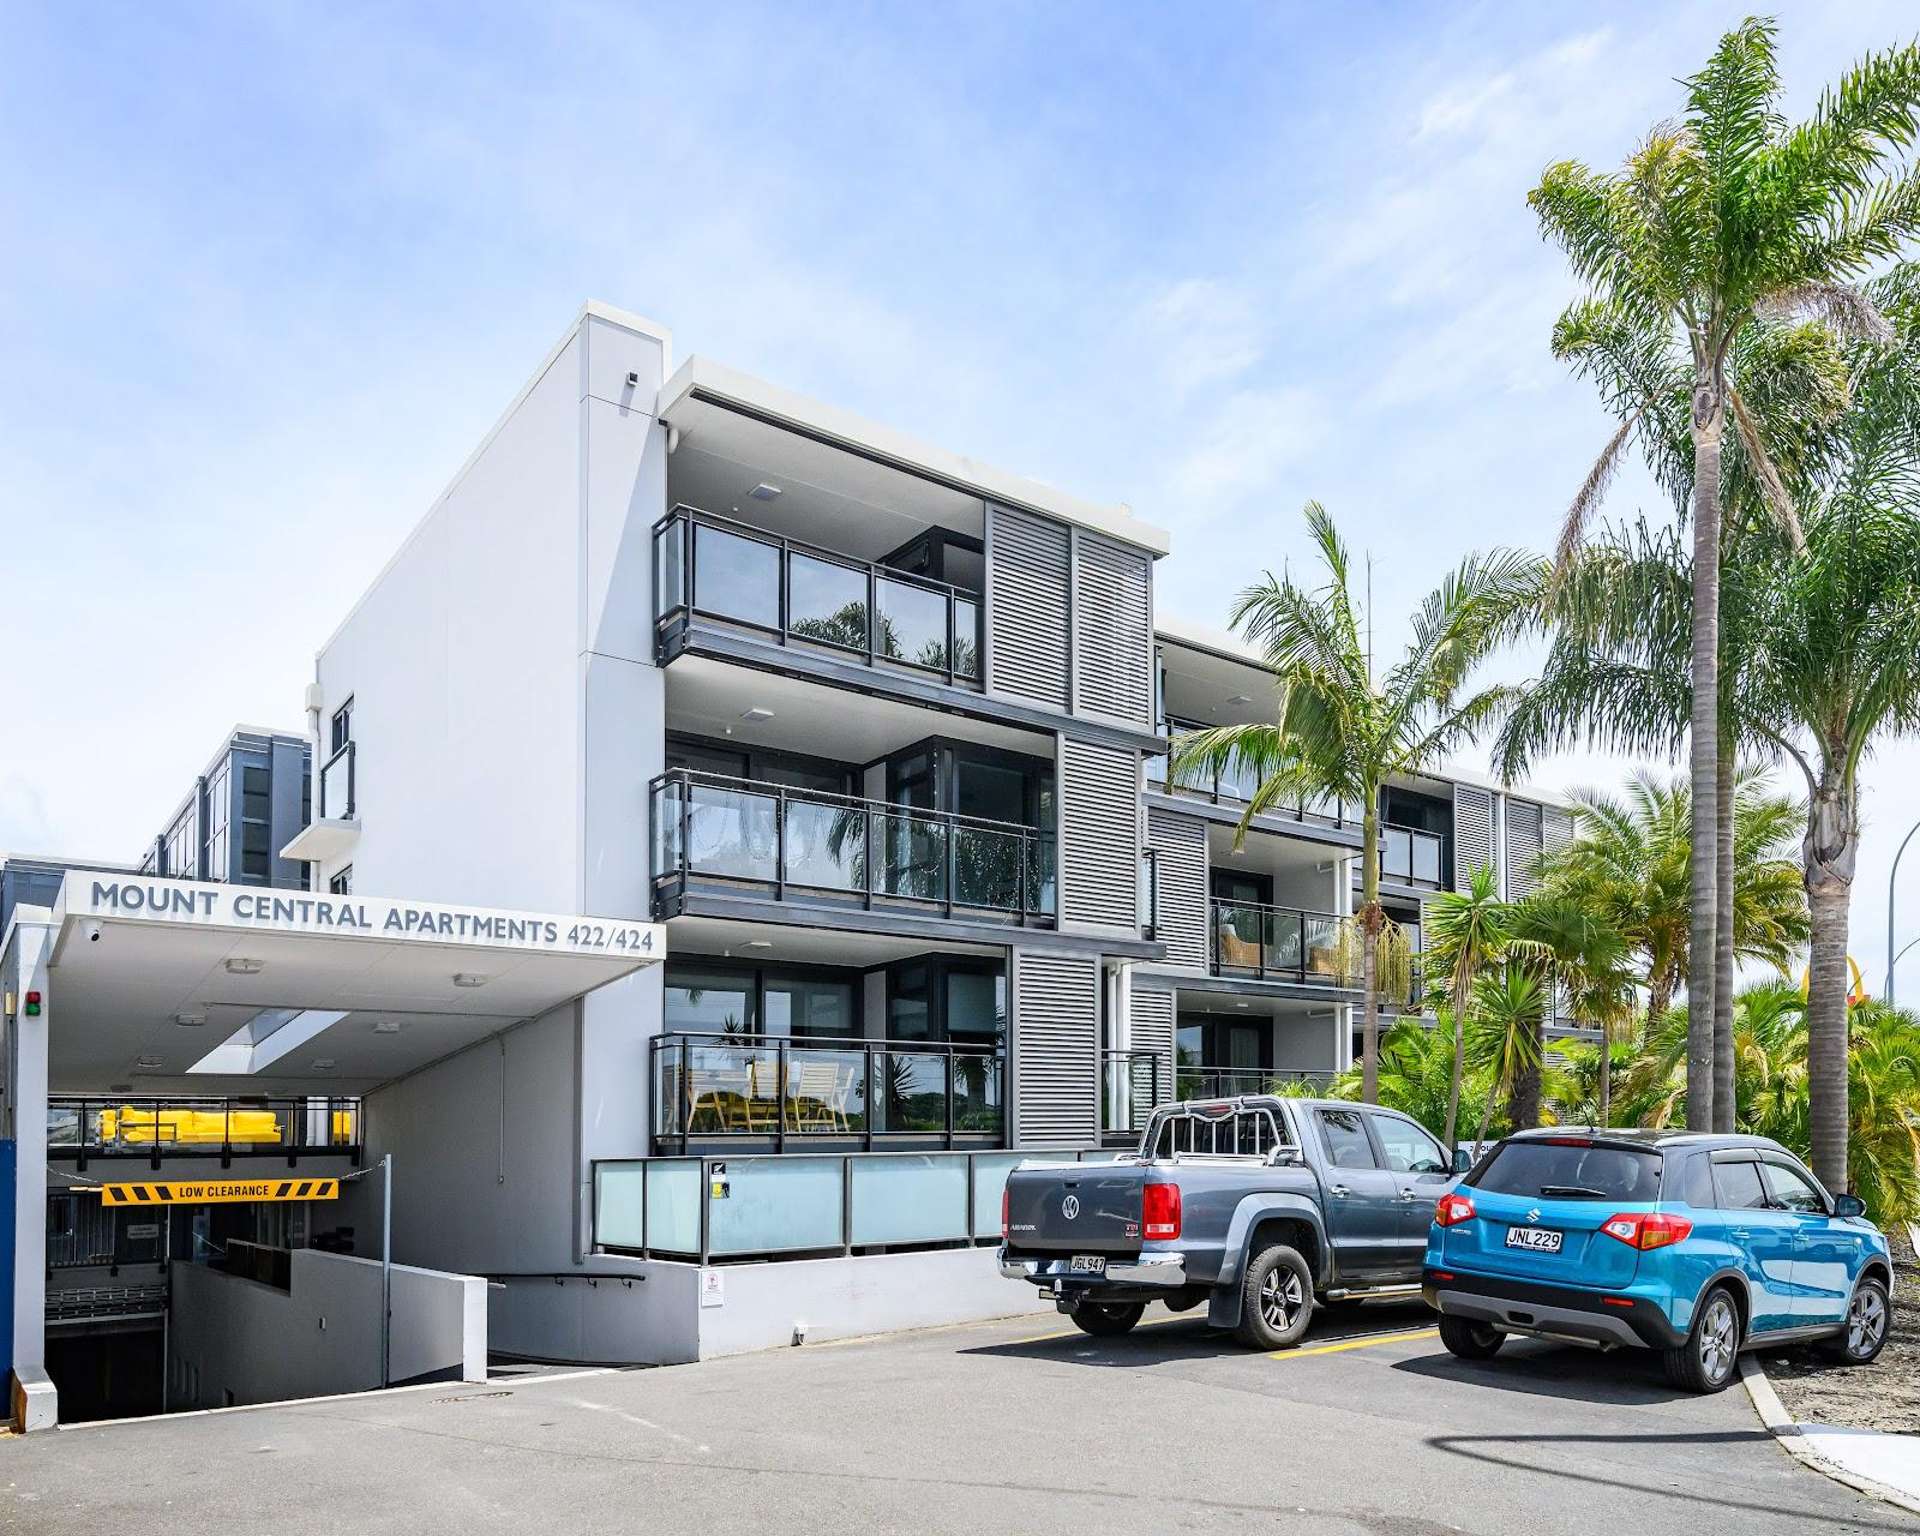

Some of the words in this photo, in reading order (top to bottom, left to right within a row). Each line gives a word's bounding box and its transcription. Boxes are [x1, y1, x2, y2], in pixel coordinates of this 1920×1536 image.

[91, 881, 218, 915] MOUNT
[233, 894, 372, 928] CENTRAL
[384, 908, 558, 943] APARTMENTS
[567, 924, 653, 951] 422/424
[179, 1187, 204, 1198] LOW
[207, 1185, 269, 1197] CLEARANCE
[1508, 1229, 1560, 1248] JNL229
